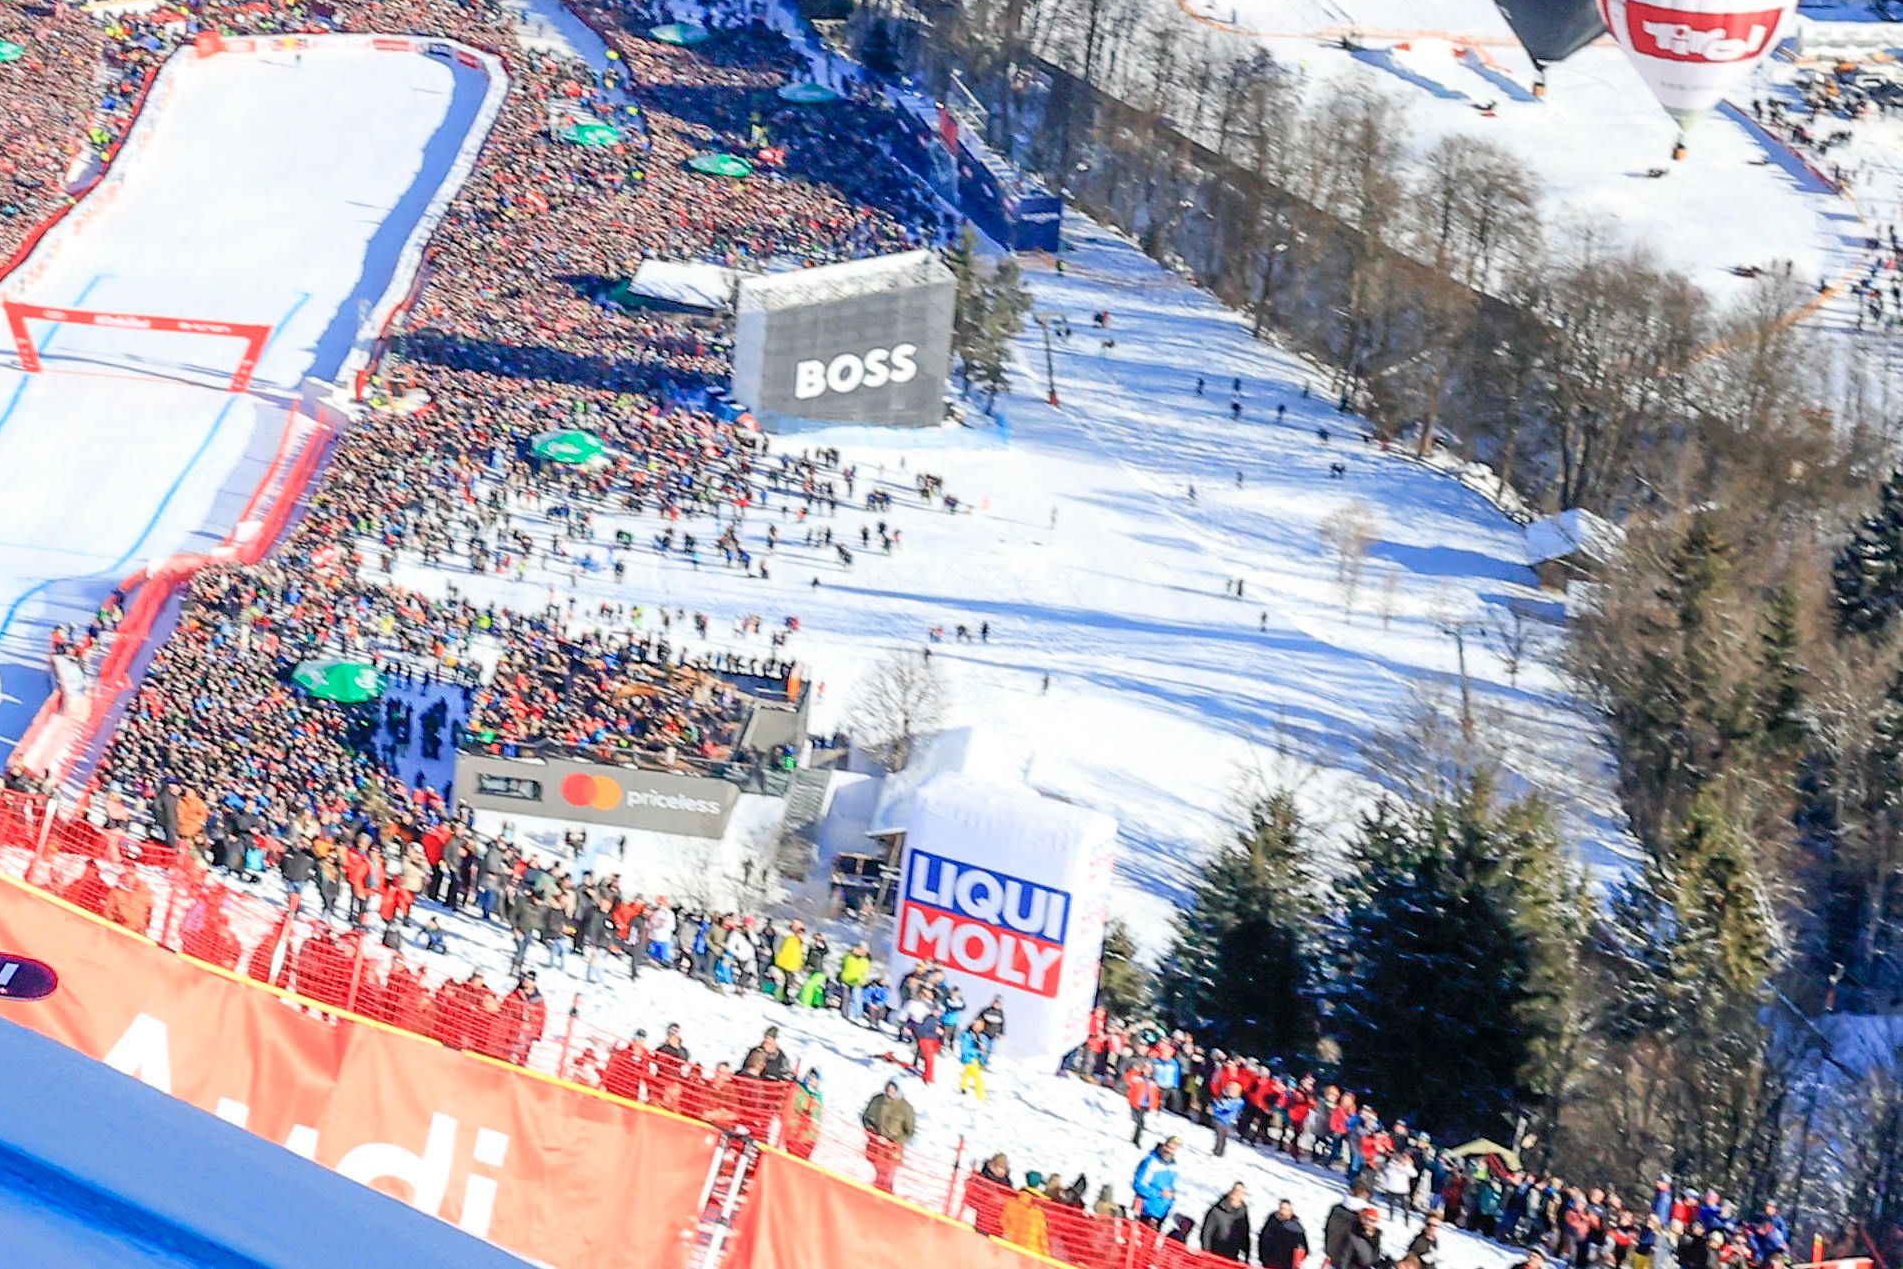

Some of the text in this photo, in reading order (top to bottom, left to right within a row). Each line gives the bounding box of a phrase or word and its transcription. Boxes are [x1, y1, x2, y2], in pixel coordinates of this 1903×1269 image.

[1641, 19, 1768, 62] Tirol
[794, 342, 918, 401] BOSS
[625, 788, 723, 816] priceless
[909, 852, 1067, 943] LIQUI
[902, 905, 1064, 992] MOLY
